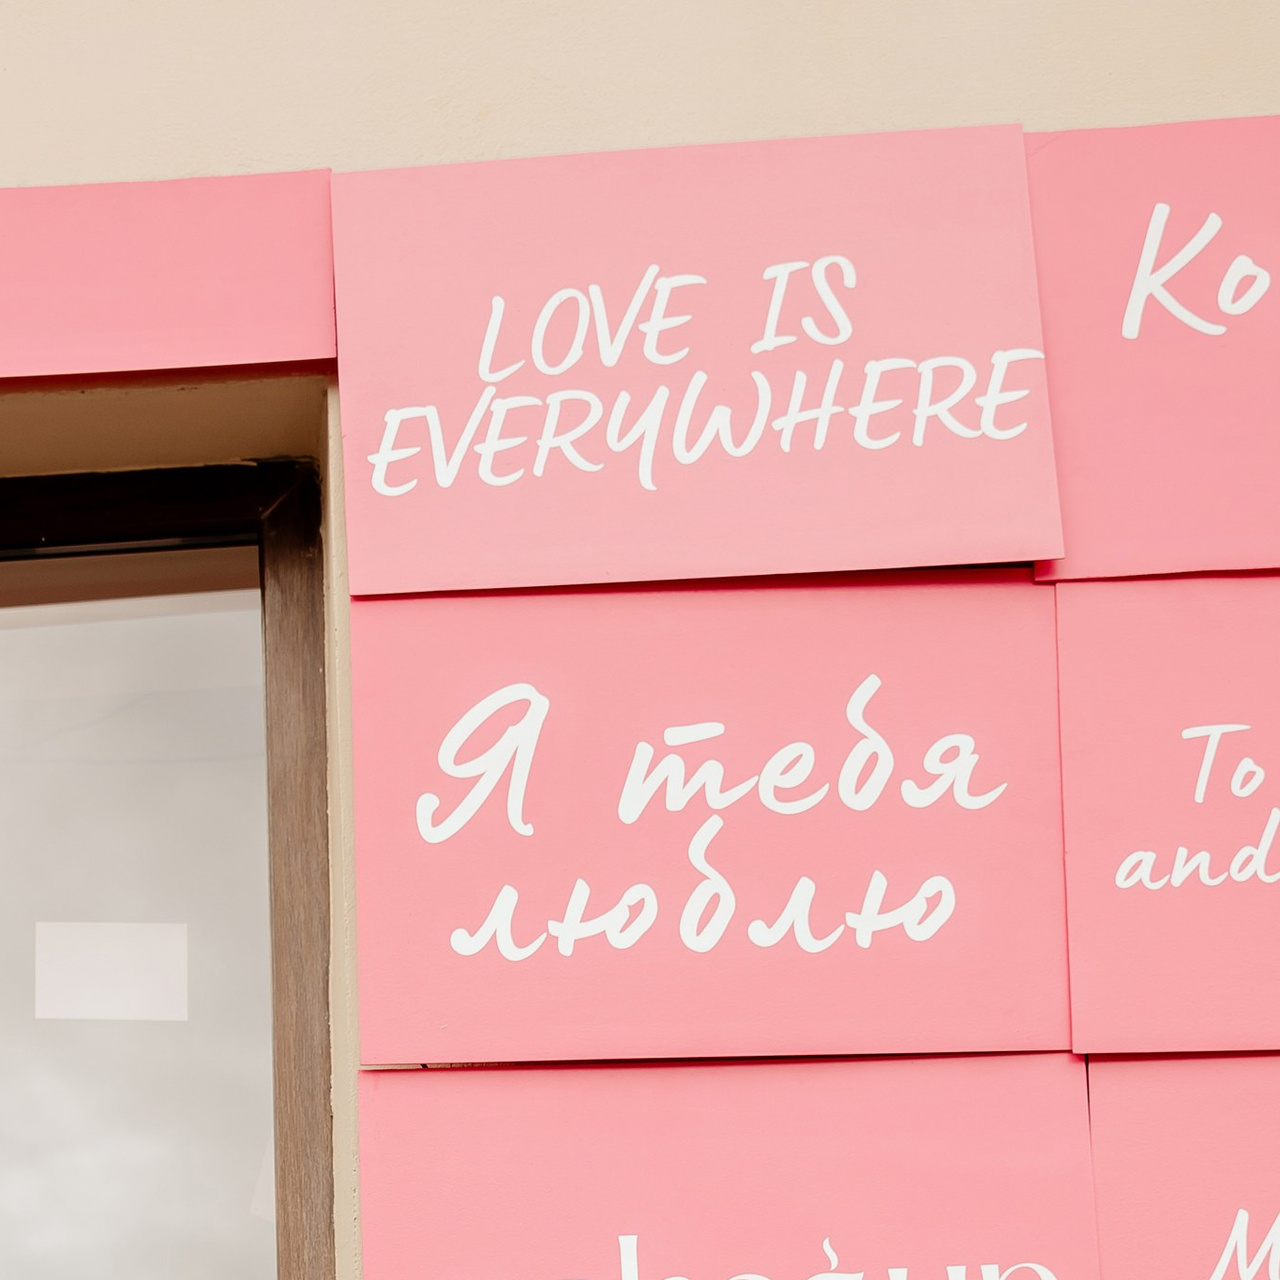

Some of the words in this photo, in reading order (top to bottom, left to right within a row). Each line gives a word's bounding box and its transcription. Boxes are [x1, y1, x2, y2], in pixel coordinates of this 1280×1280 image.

[478, 265, 706, 383] LOVE
[750, 255, 857, 354] IS
[1121, 203, 1271, 340] Ko
[367, 348, 1045, 496] EVERYWHERE
[415, 683, 550, 844] Я
[617, 674, 1007, 825] тебя
[1181, 724, 1266, 803] To
[450, 814, 957, 961] люблю
[1115, 807, 1280, 890] and
